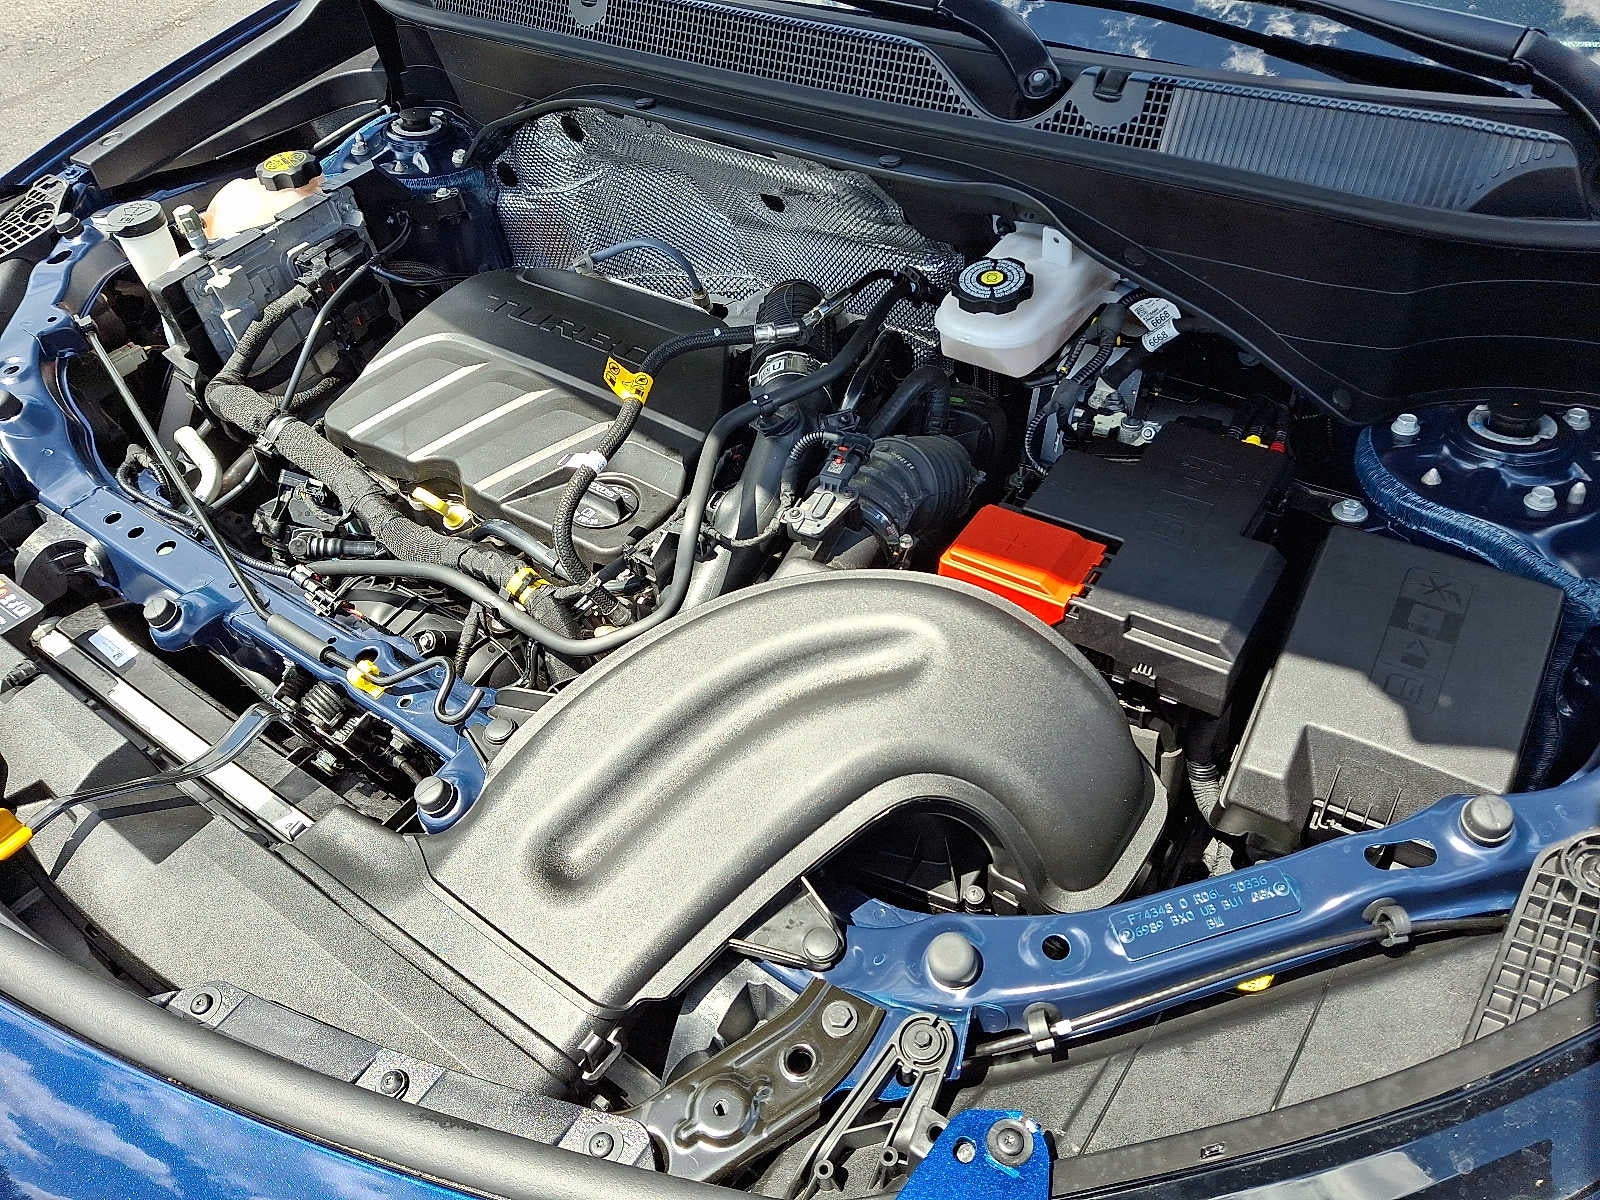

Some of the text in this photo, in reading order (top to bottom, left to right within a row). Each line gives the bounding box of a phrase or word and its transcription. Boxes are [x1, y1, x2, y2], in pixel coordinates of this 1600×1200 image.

[484, 295, 650, 367] TURBO
[1149, 331, 1168, 347] 6668
[1229, 875, 1268, 894] 30336
